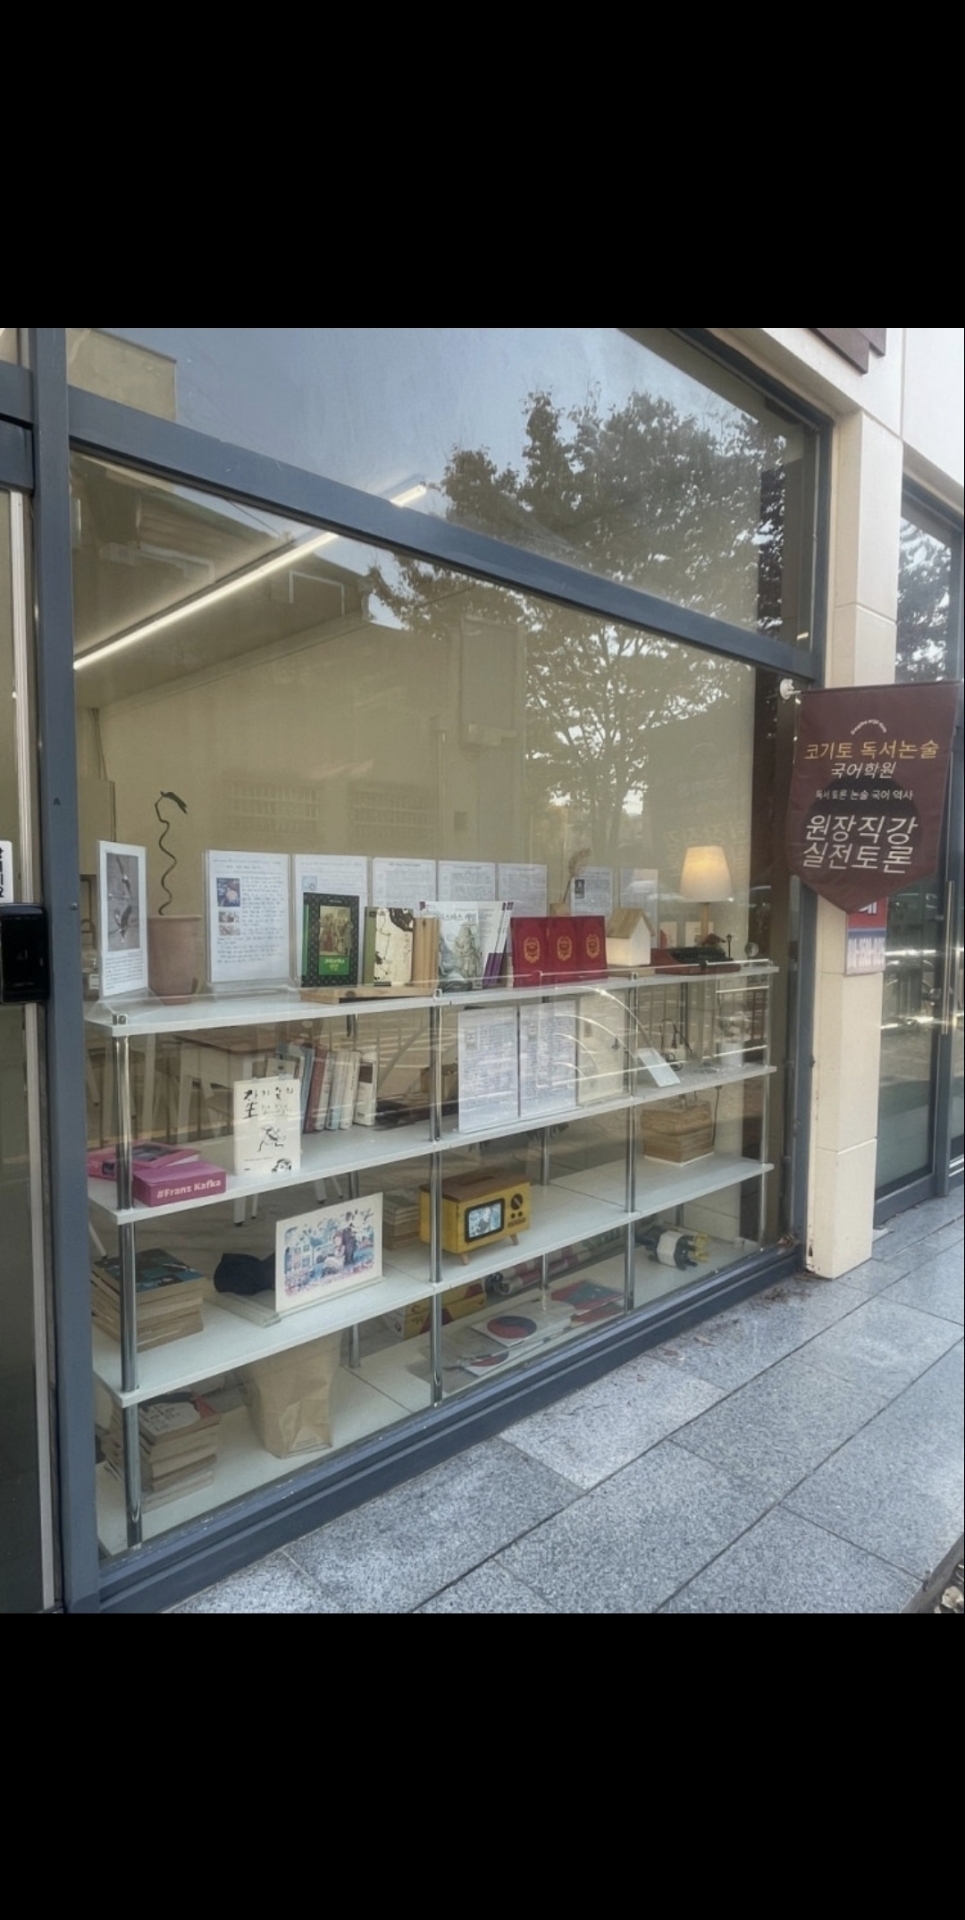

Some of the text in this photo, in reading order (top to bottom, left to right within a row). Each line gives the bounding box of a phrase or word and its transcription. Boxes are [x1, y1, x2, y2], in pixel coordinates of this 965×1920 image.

[804, 739, 940, 760] 코기토 독서논술
[831, 761, 896, 779] 국어학원
[850, 789, 869, 801] 논술
[871, 789, 891, 801] 국어
[892, 789, 914, 801] 역사
[806, 815, 918, 845] 원장직강
[803, 842, 913, 874] 실전토론
[157, 1179, 222, 1199] #Franz Kafka
